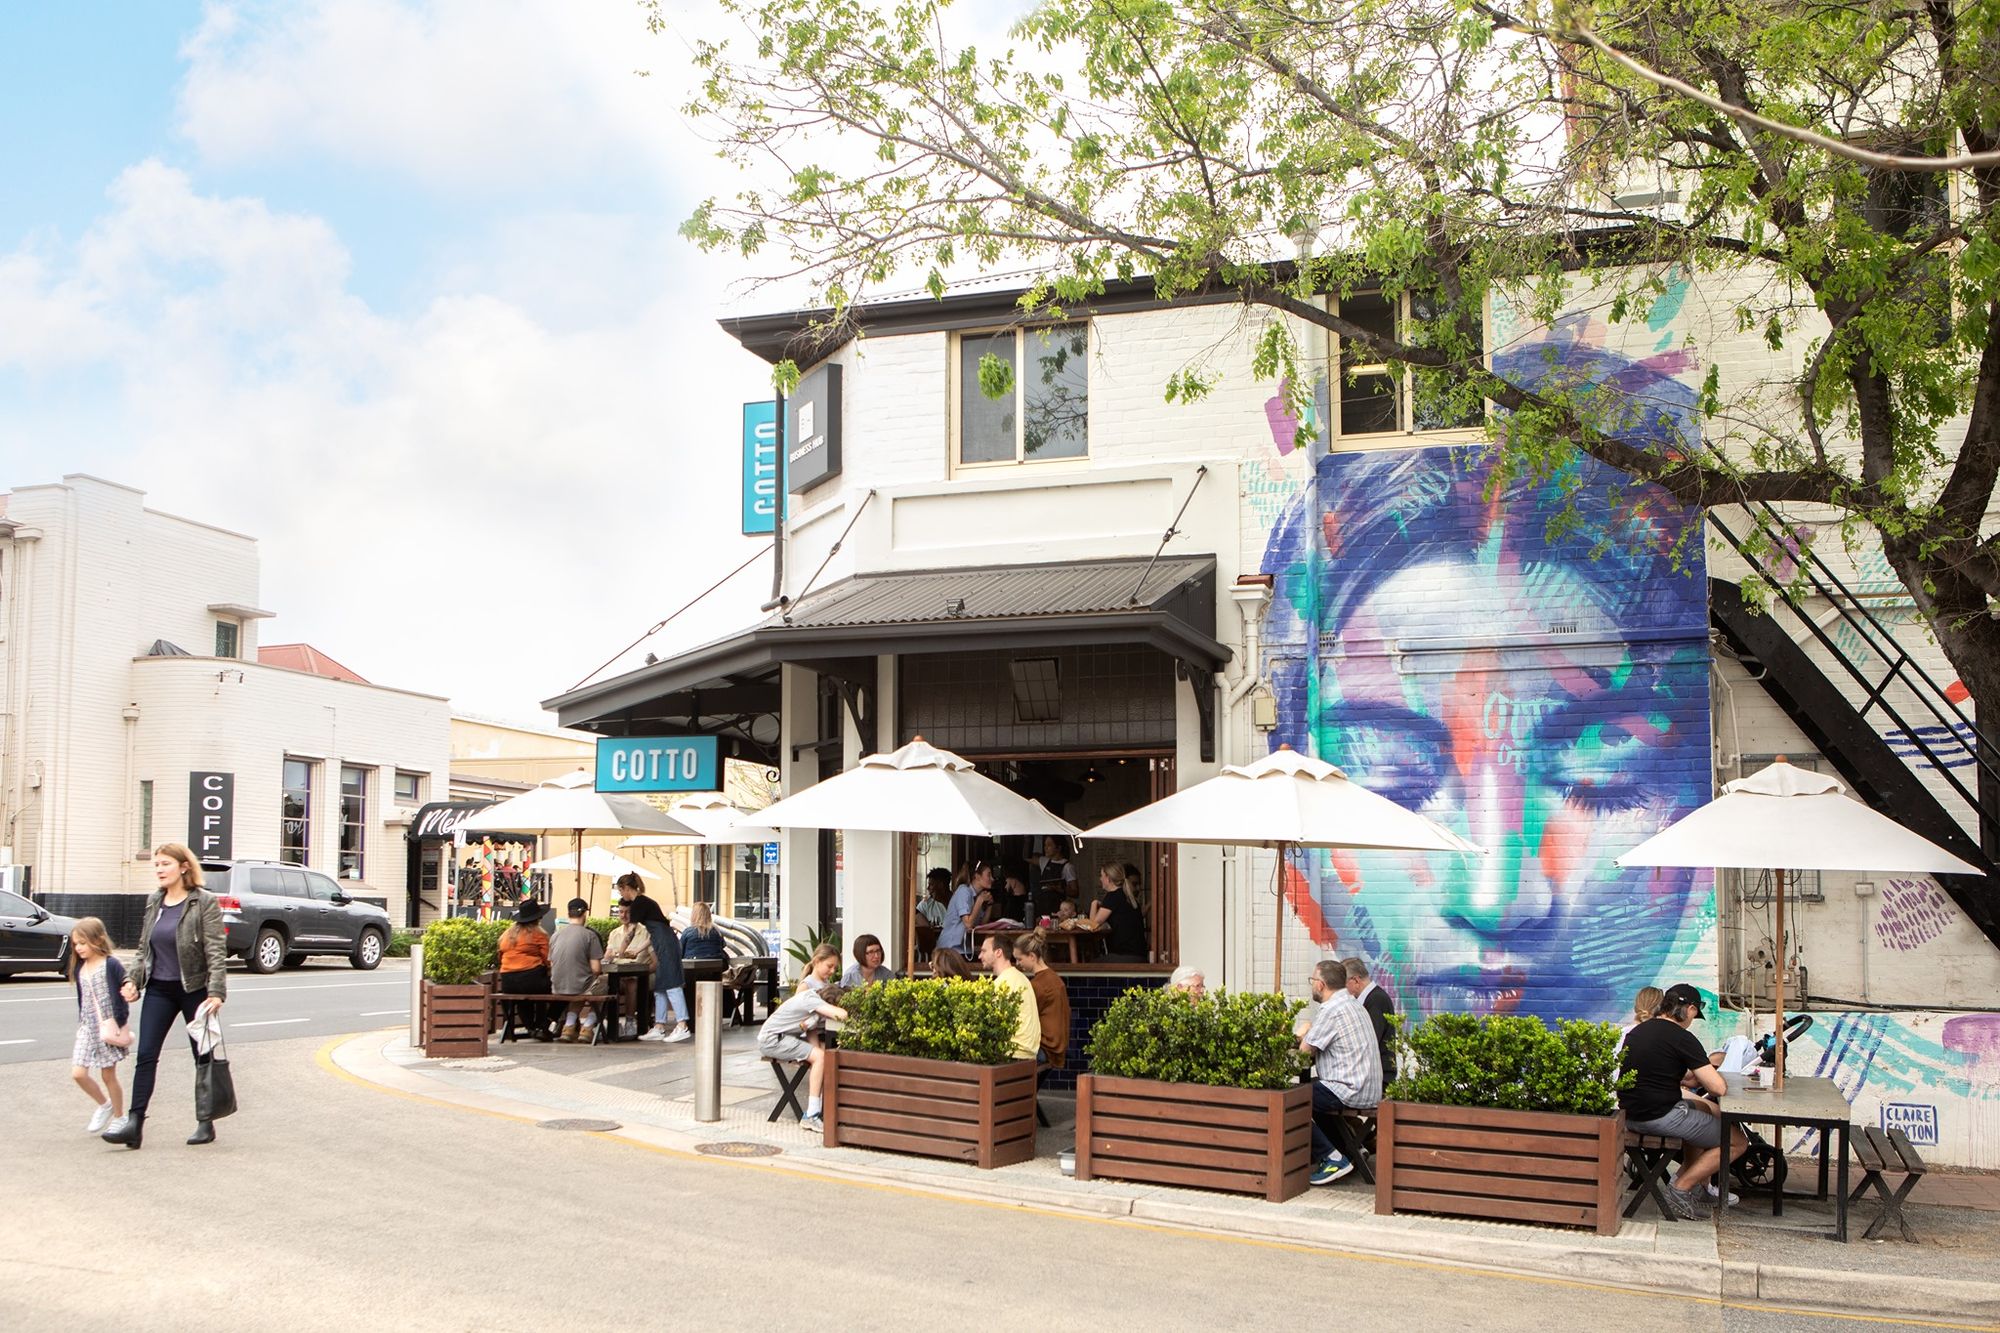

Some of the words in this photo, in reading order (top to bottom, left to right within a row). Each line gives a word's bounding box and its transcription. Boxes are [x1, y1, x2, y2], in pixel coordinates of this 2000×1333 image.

[789, 441, 814, 464] BUSINESS
[754, 421, 776, 515] COTTO
[612, 748, 697, 780] COTTO
[1886, 1107, 1931, 1123] CLAIRE
